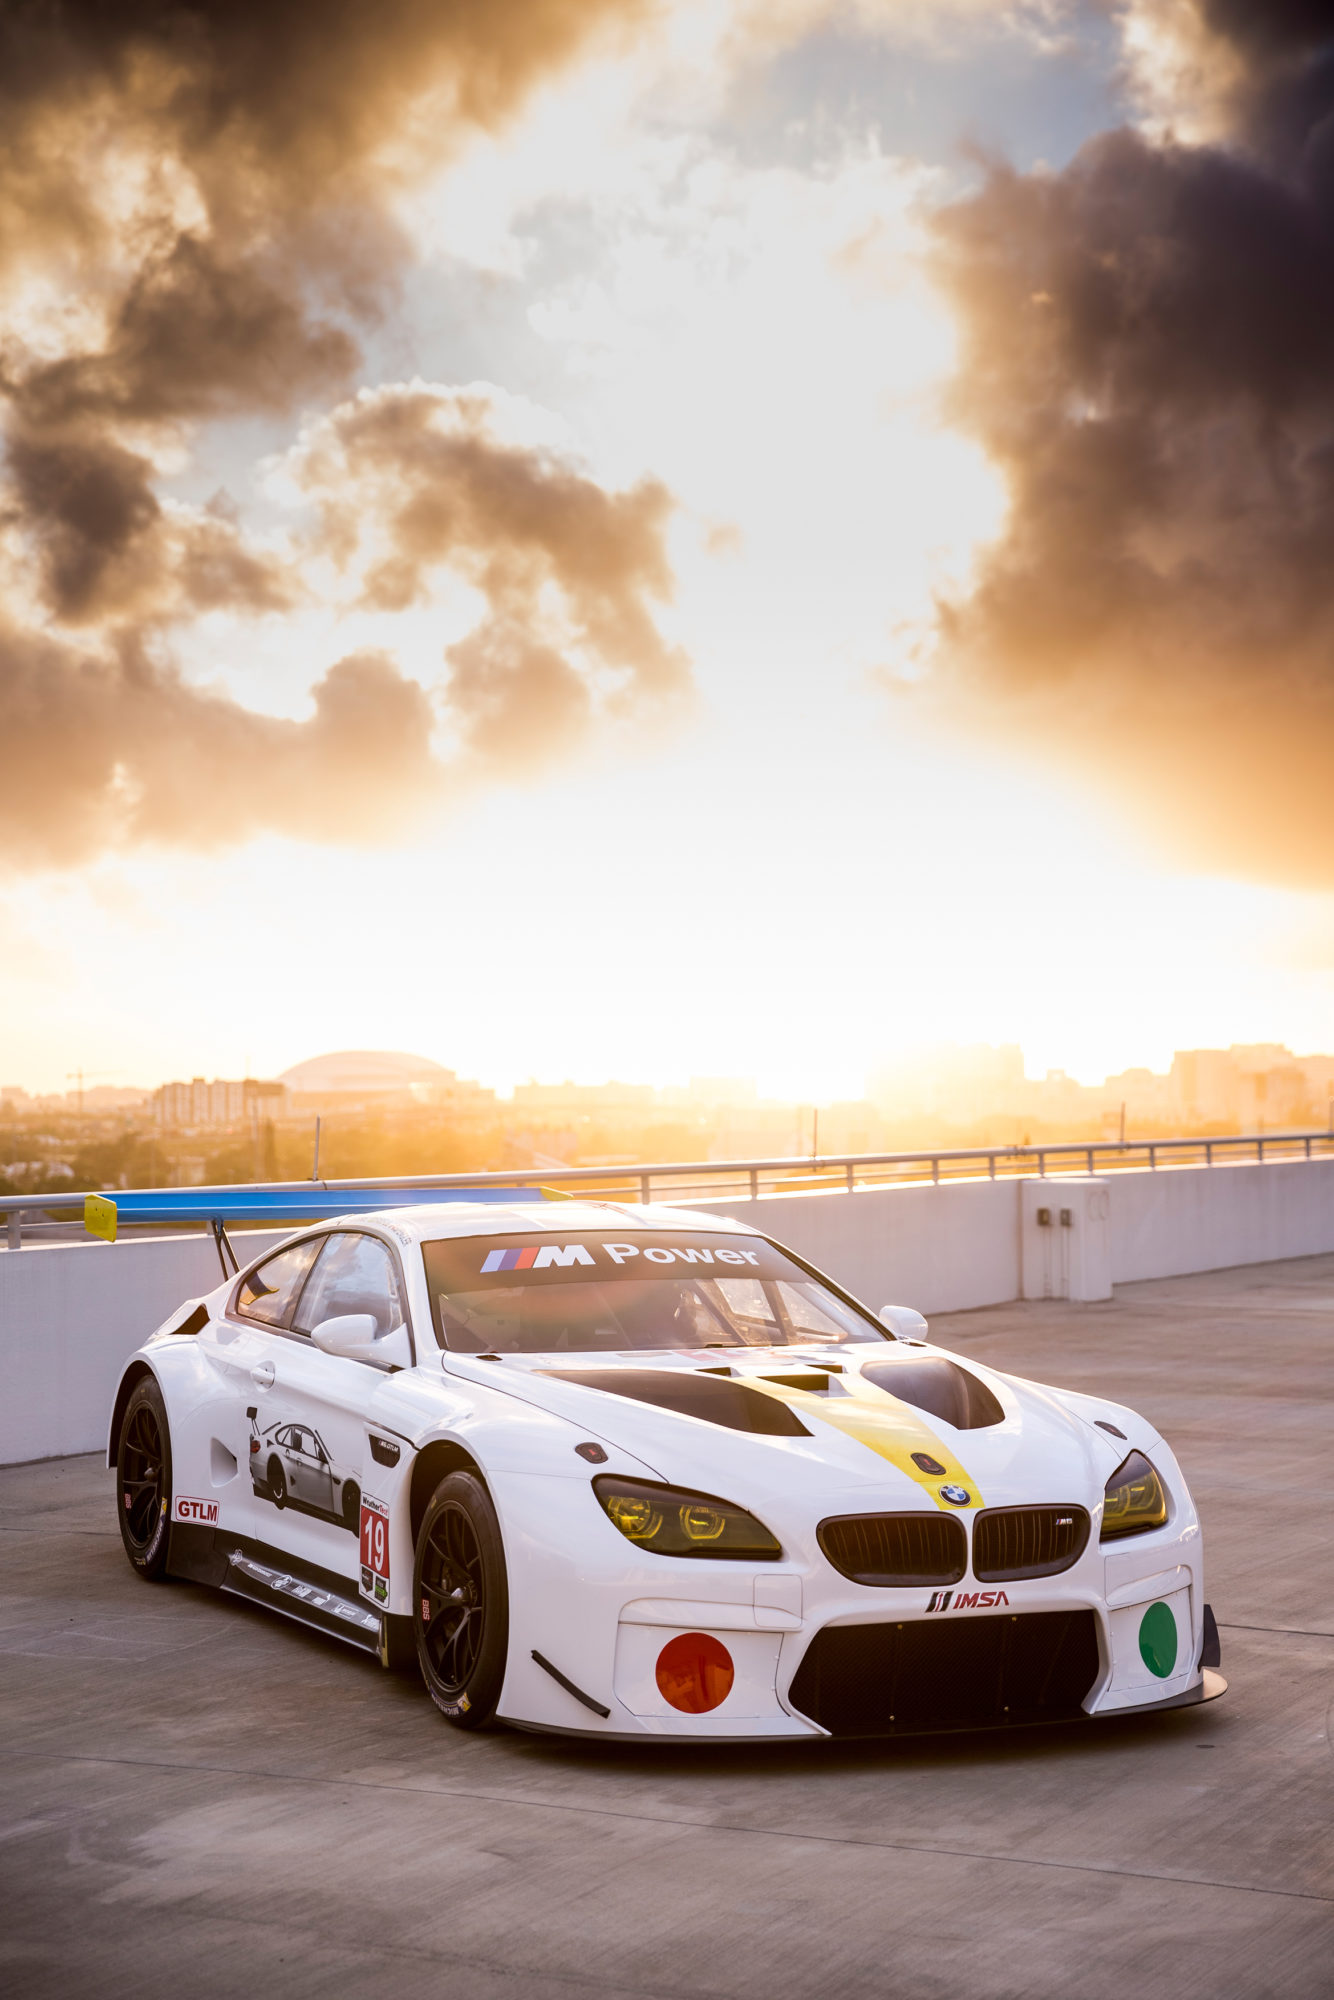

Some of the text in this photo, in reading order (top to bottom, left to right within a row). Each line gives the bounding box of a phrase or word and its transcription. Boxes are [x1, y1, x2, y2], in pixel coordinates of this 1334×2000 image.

[602, 1243, 760, 1265] Power
[178, 1500, 218, 1522] GTLM
[365, 1515, 384, 1571] 19
[422, 1599, 431, 1621] BBS
[953, 1591, 1009, 1609] IMSA
